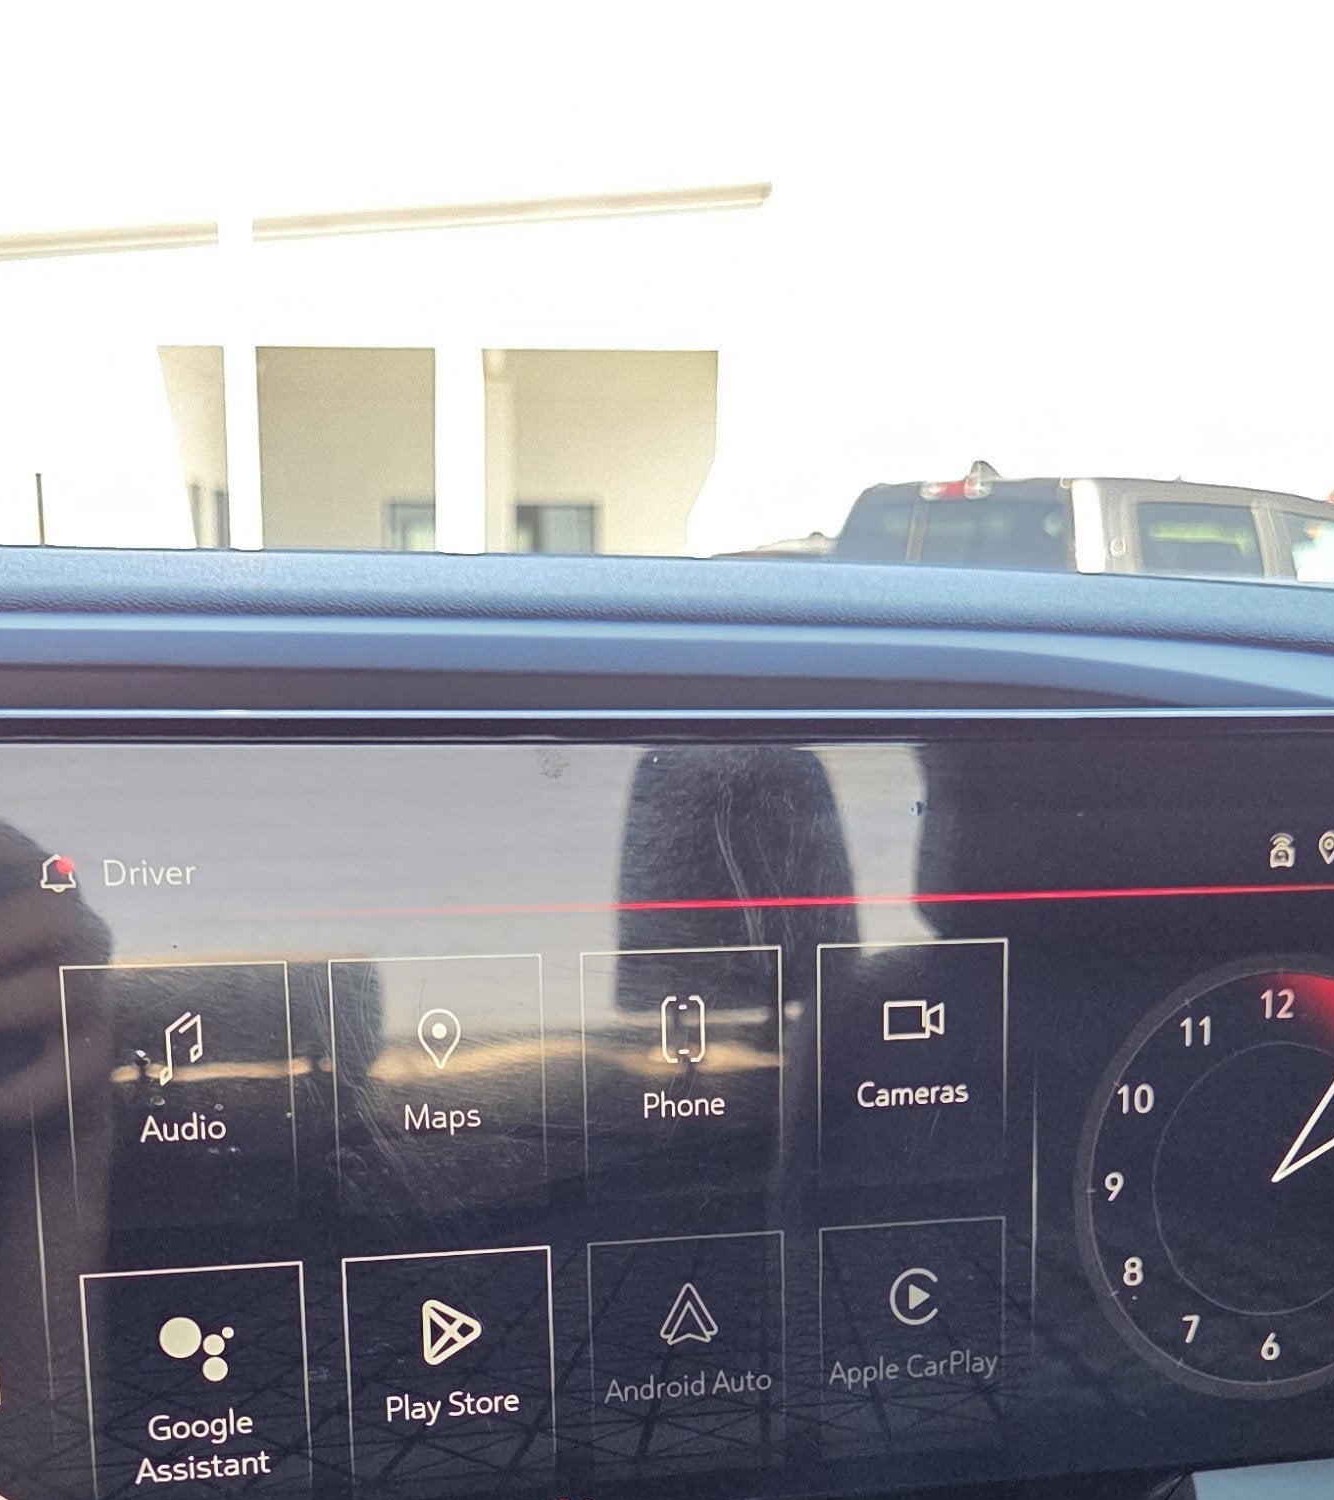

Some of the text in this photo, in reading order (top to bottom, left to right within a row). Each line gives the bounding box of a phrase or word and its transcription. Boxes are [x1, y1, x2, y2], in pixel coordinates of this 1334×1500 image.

[102, 858, 197, 886] Driver
[1260, 989, 1295, 1019] 12
[1181, 1016, 1212, 1046] 11
[642, 1091, 726, 1119] Phone
[857, 1081, 969, 1108] Cameras
[1117, 1084, 1155, 1113] 10
[140, 1113, 227, 1143] Audio
[403, 1103, 481, 1134] Maps
[1104, 1172, 1124, 1202] 9
[1123, 1257, 1143, 1287] 8
[1183, 1316, 1200, 1343] 7
[1261, 1333, 1281, 1361] 6
[828, 1351, 999, 1387] Apple CarPlay
[604, 1369, 772, 1404] Android Auto
[386, 1390, 520, 1426] Play Store
[148, 1410, 254, 1447] Google
[135, 1450, 271, 1485] Assistant
